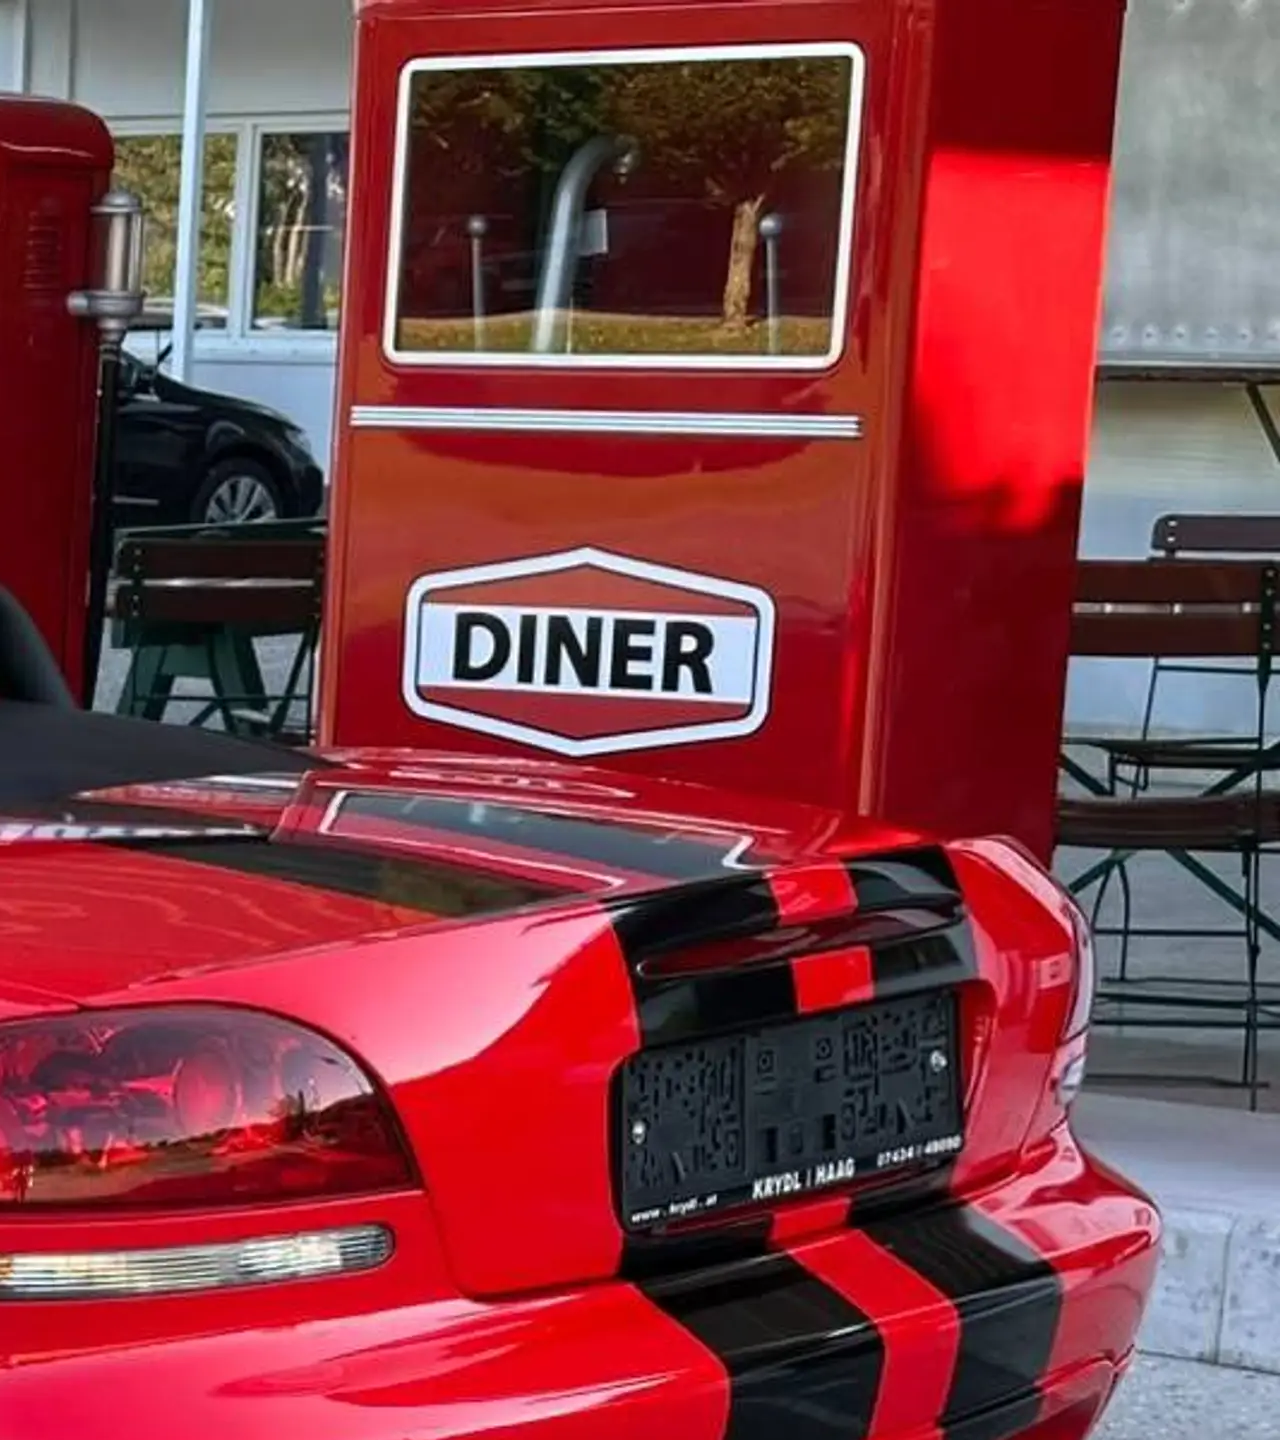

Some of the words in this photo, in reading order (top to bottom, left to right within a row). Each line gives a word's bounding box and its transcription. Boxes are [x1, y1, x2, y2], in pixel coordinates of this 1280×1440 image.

[452, 611, 714, 694] DINER
[752, 1170, 802, 1200] KRYDL
[814, 1156, 856, 1185] HAAG
